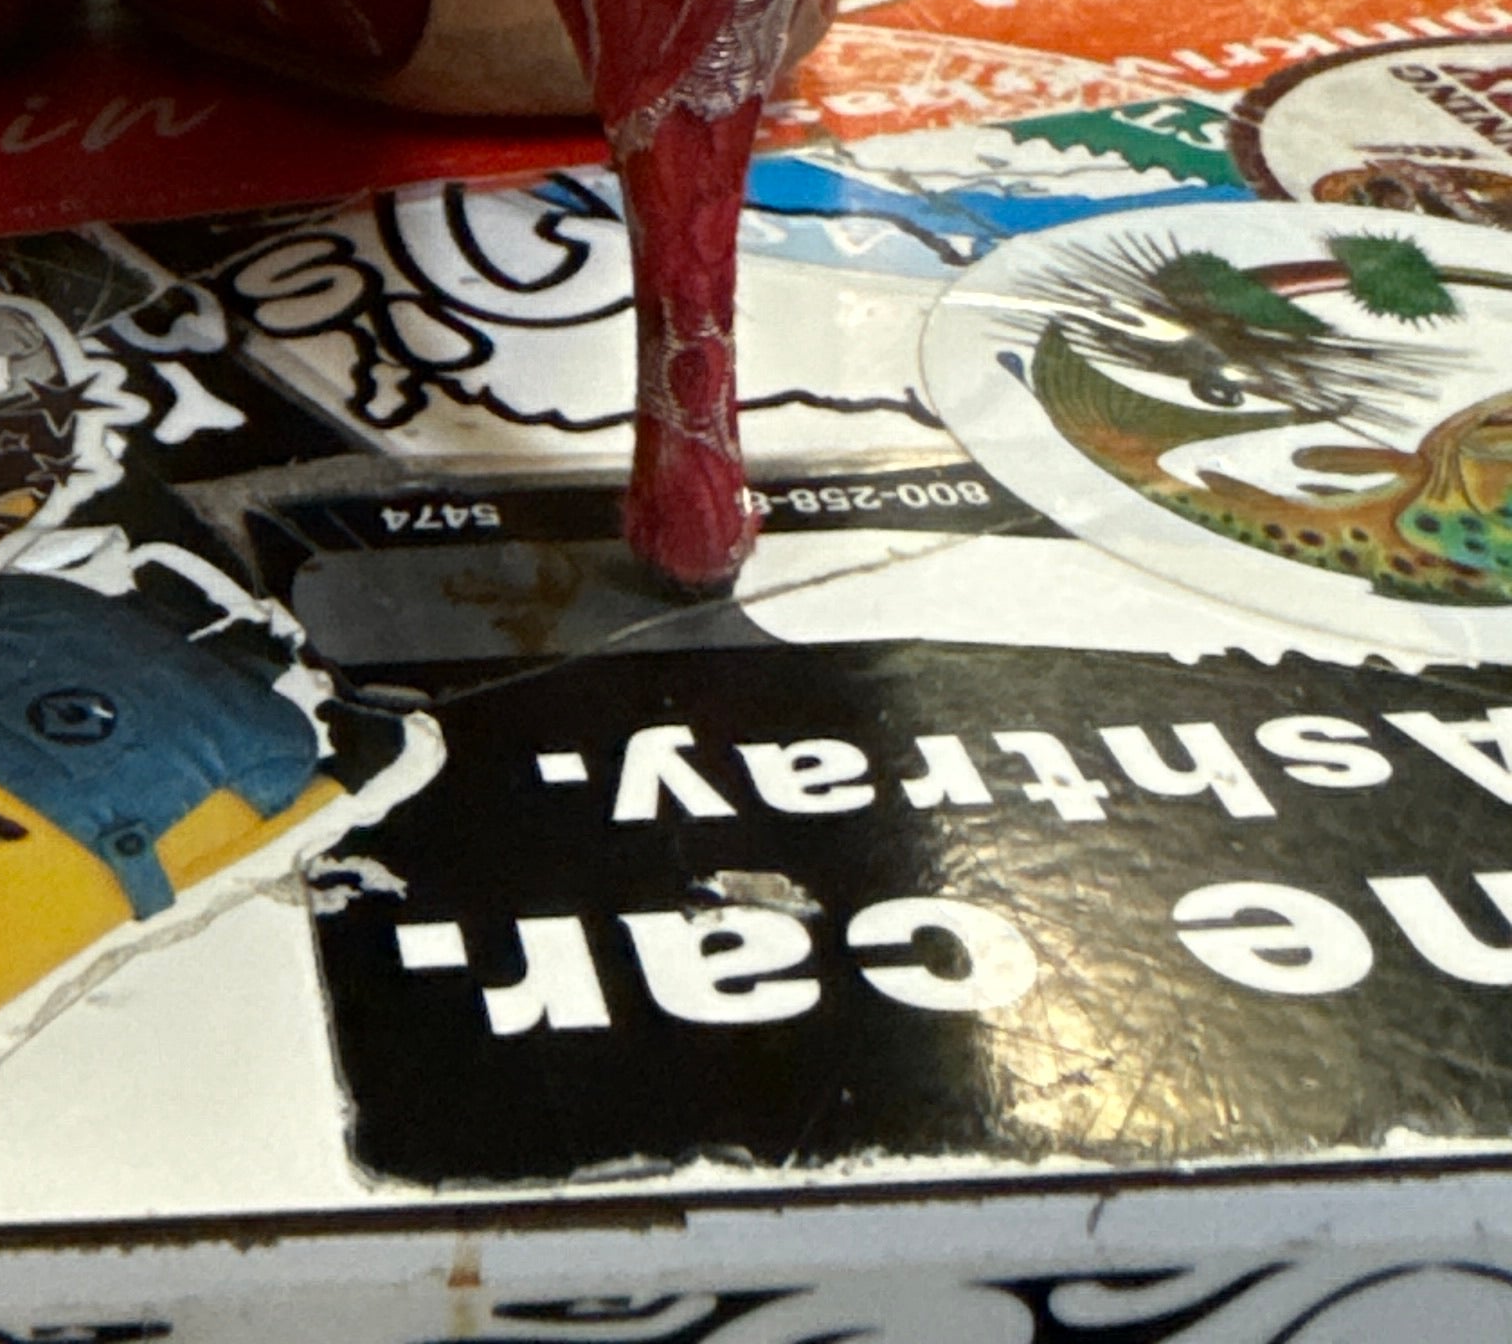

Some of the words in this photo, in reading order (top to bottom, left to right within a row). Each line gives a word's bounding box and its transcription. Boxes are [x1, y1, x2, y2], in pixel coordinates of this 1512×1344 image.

[378, 502, 502, 533] 5474
[534, 710, 1512, 824] Ashtray.
[396, 896, 1038, 1038] car.
